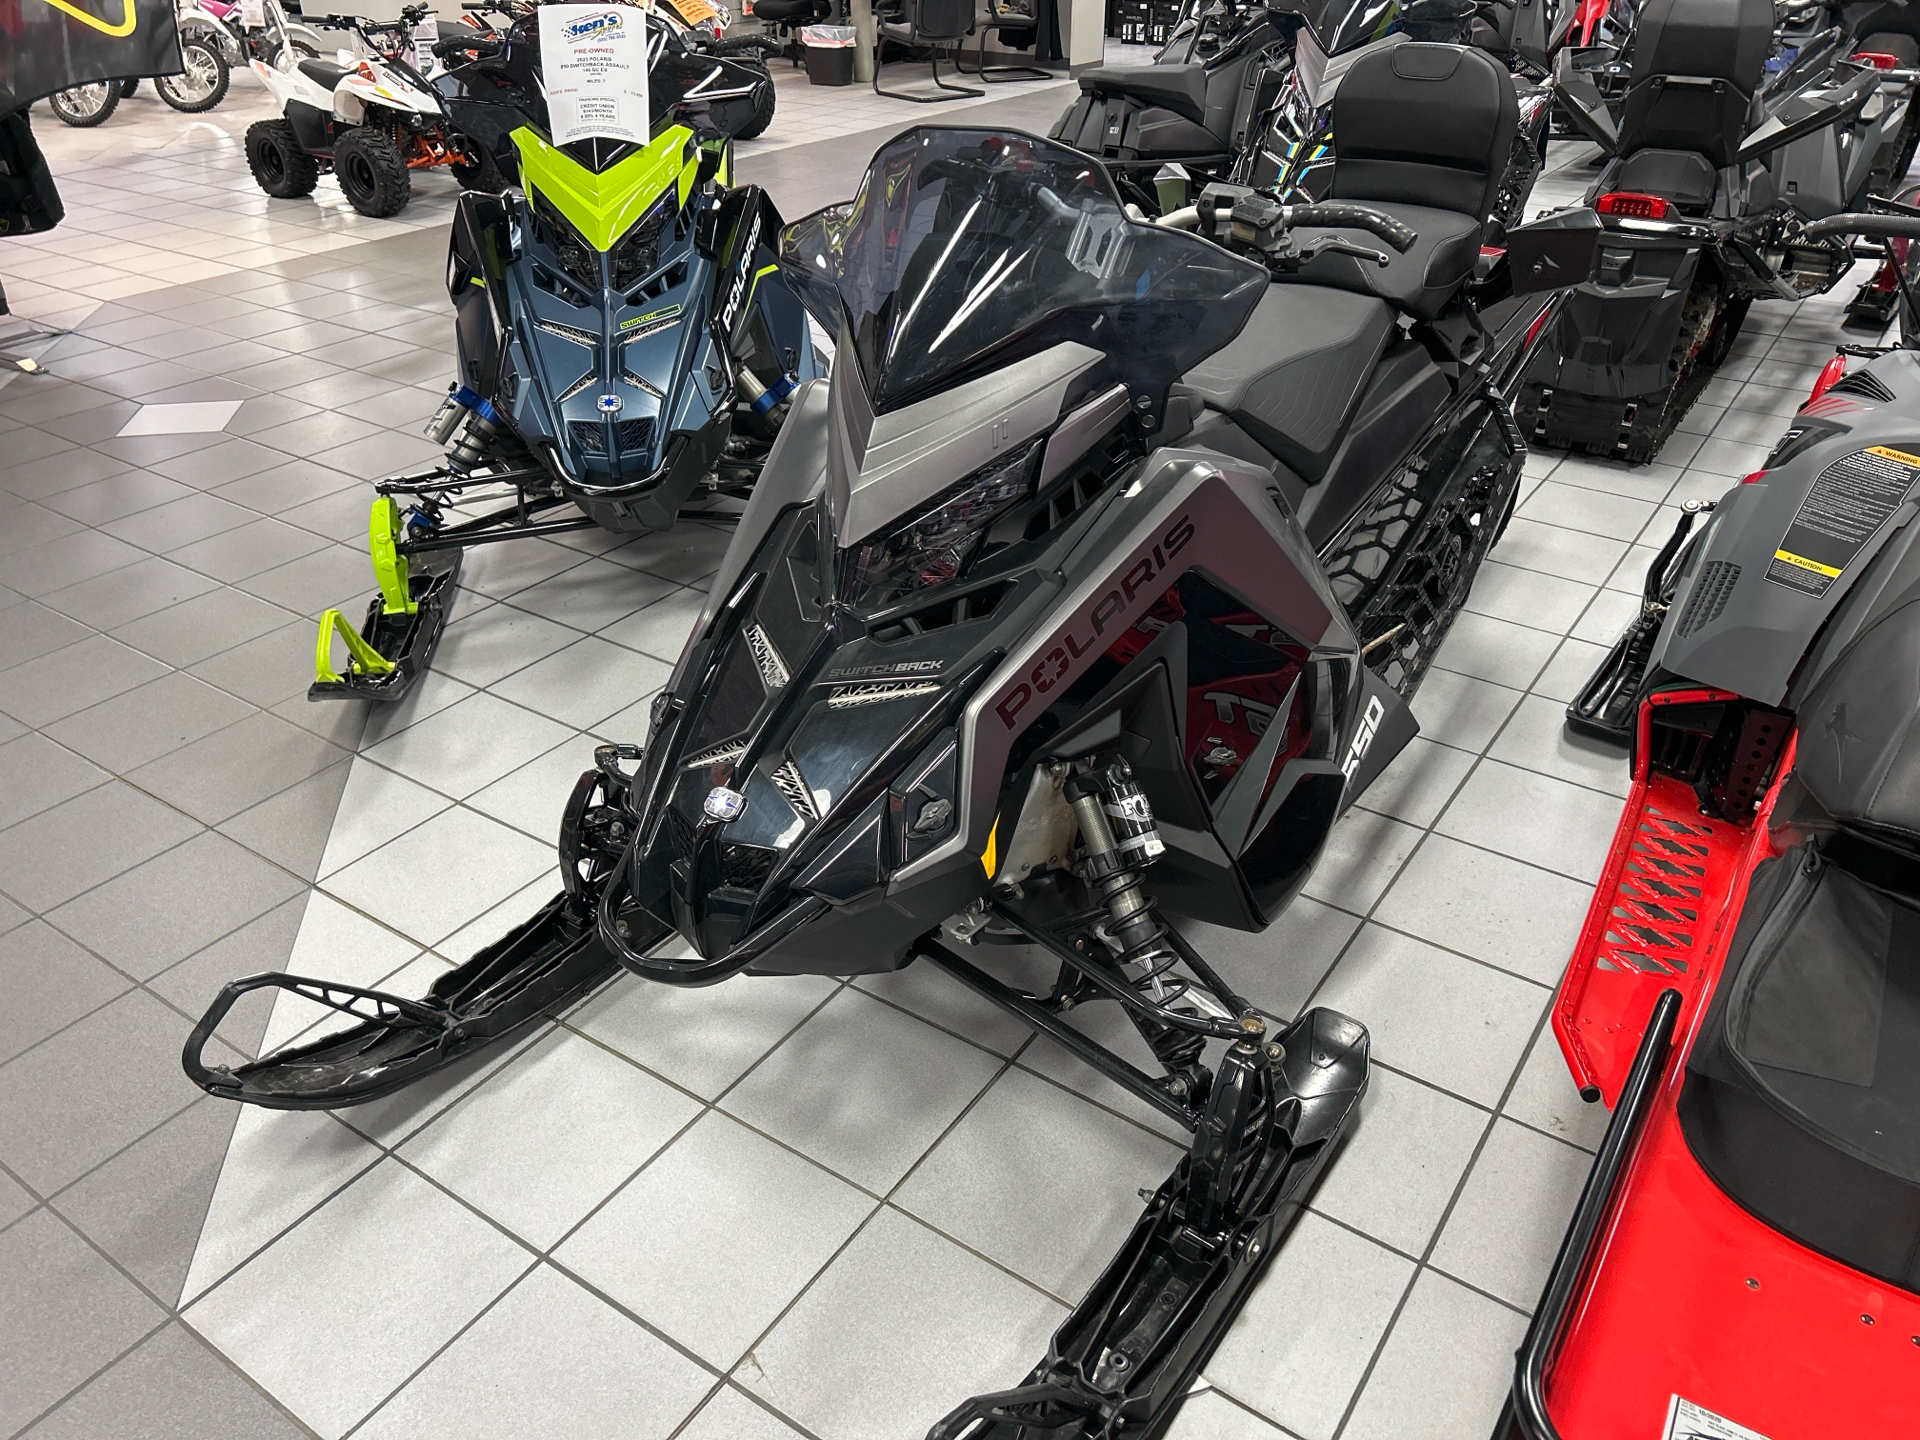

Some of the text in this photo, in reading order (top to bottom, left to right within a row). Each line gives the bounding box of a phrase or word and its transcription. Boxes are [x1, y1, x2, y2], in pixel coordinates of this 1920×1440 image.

[605, 62, 630, 70] ASSAULT
[722, 211, 762, 332] POLARIS
[619, 304, 681, 330] SWITCH
[1885, 450, 1919, 465] WARNING
[1793, 558, 1823, 571] CAUTION
[995, 513, 1195, 731] POLARIS
[828, 659, 945, 678] SWITCHBACK
